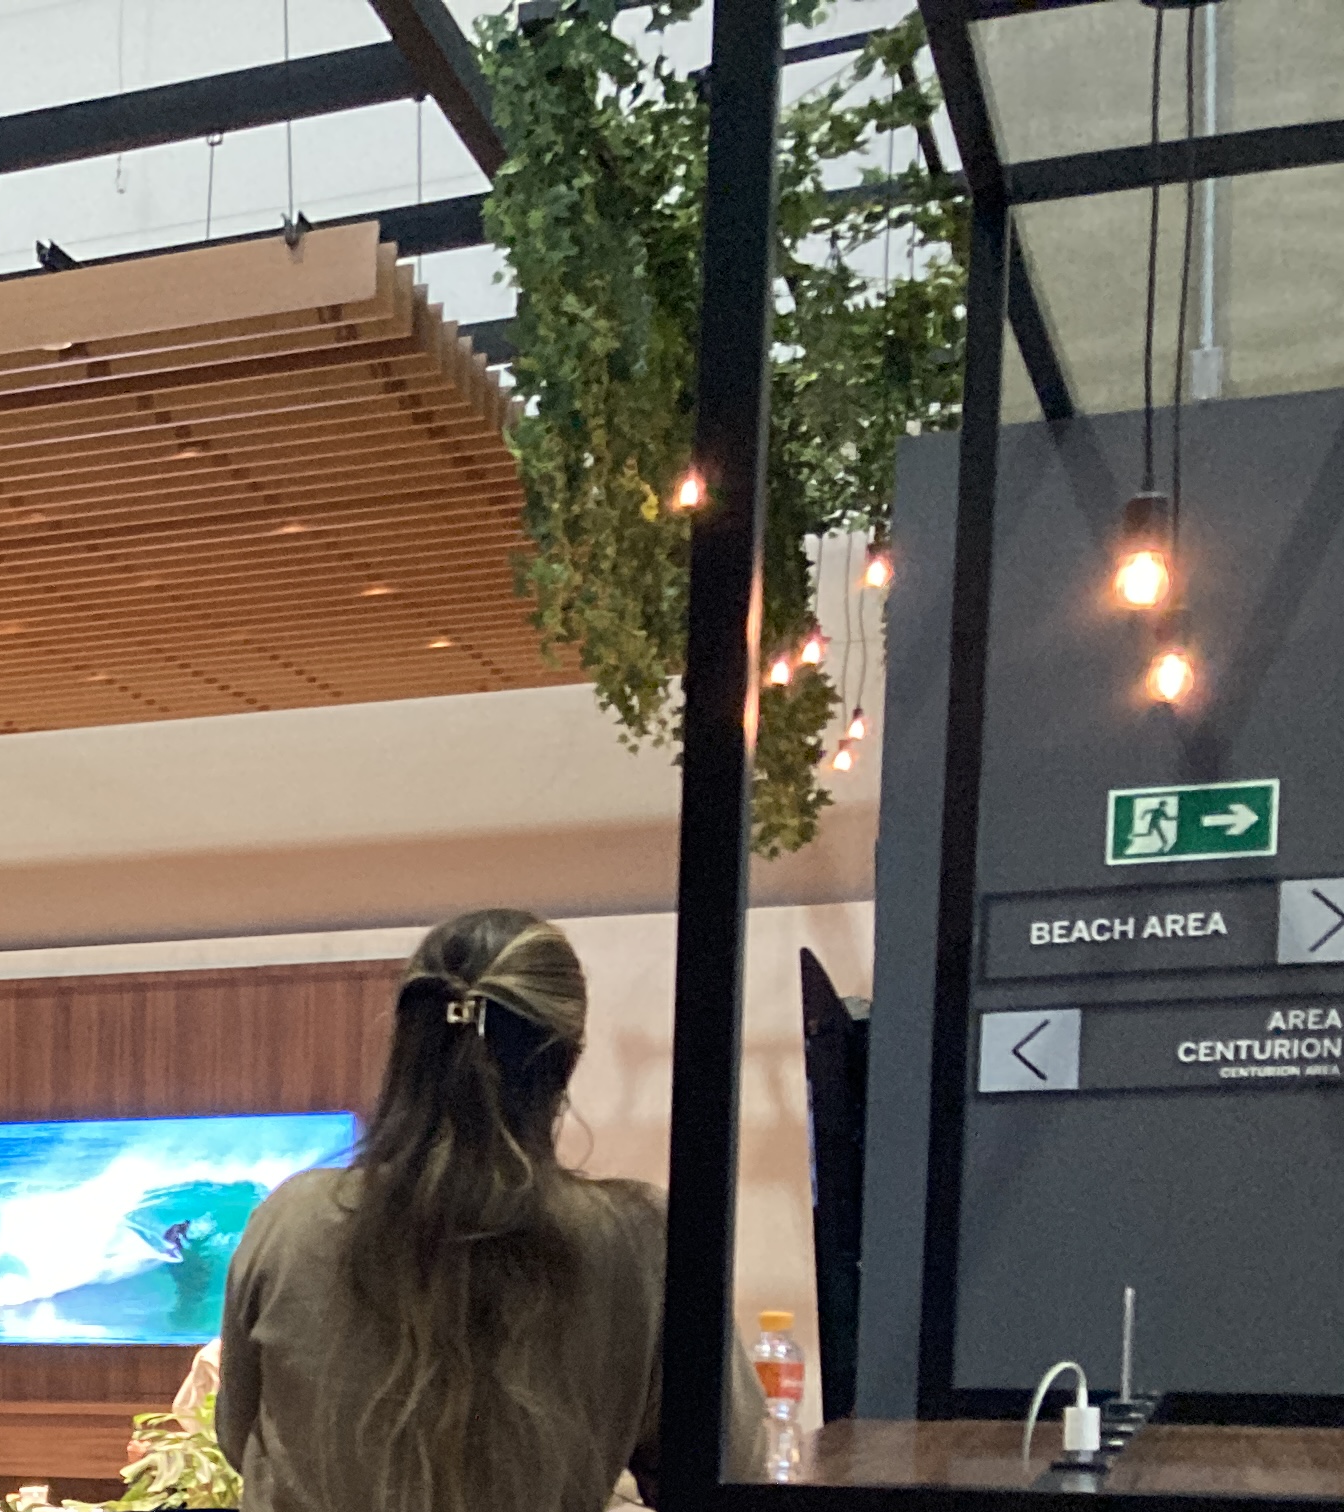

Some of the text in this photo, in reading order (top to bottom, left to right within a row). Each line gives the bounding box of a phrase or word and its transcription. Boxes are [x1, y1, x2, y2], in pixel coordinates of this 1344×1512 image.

[1029, 911, 1229, 946] BEACH AREA
[1267, 1007, 1343, 1031] AREA
[1177, 1036, 1343, 1063] CENTURION
